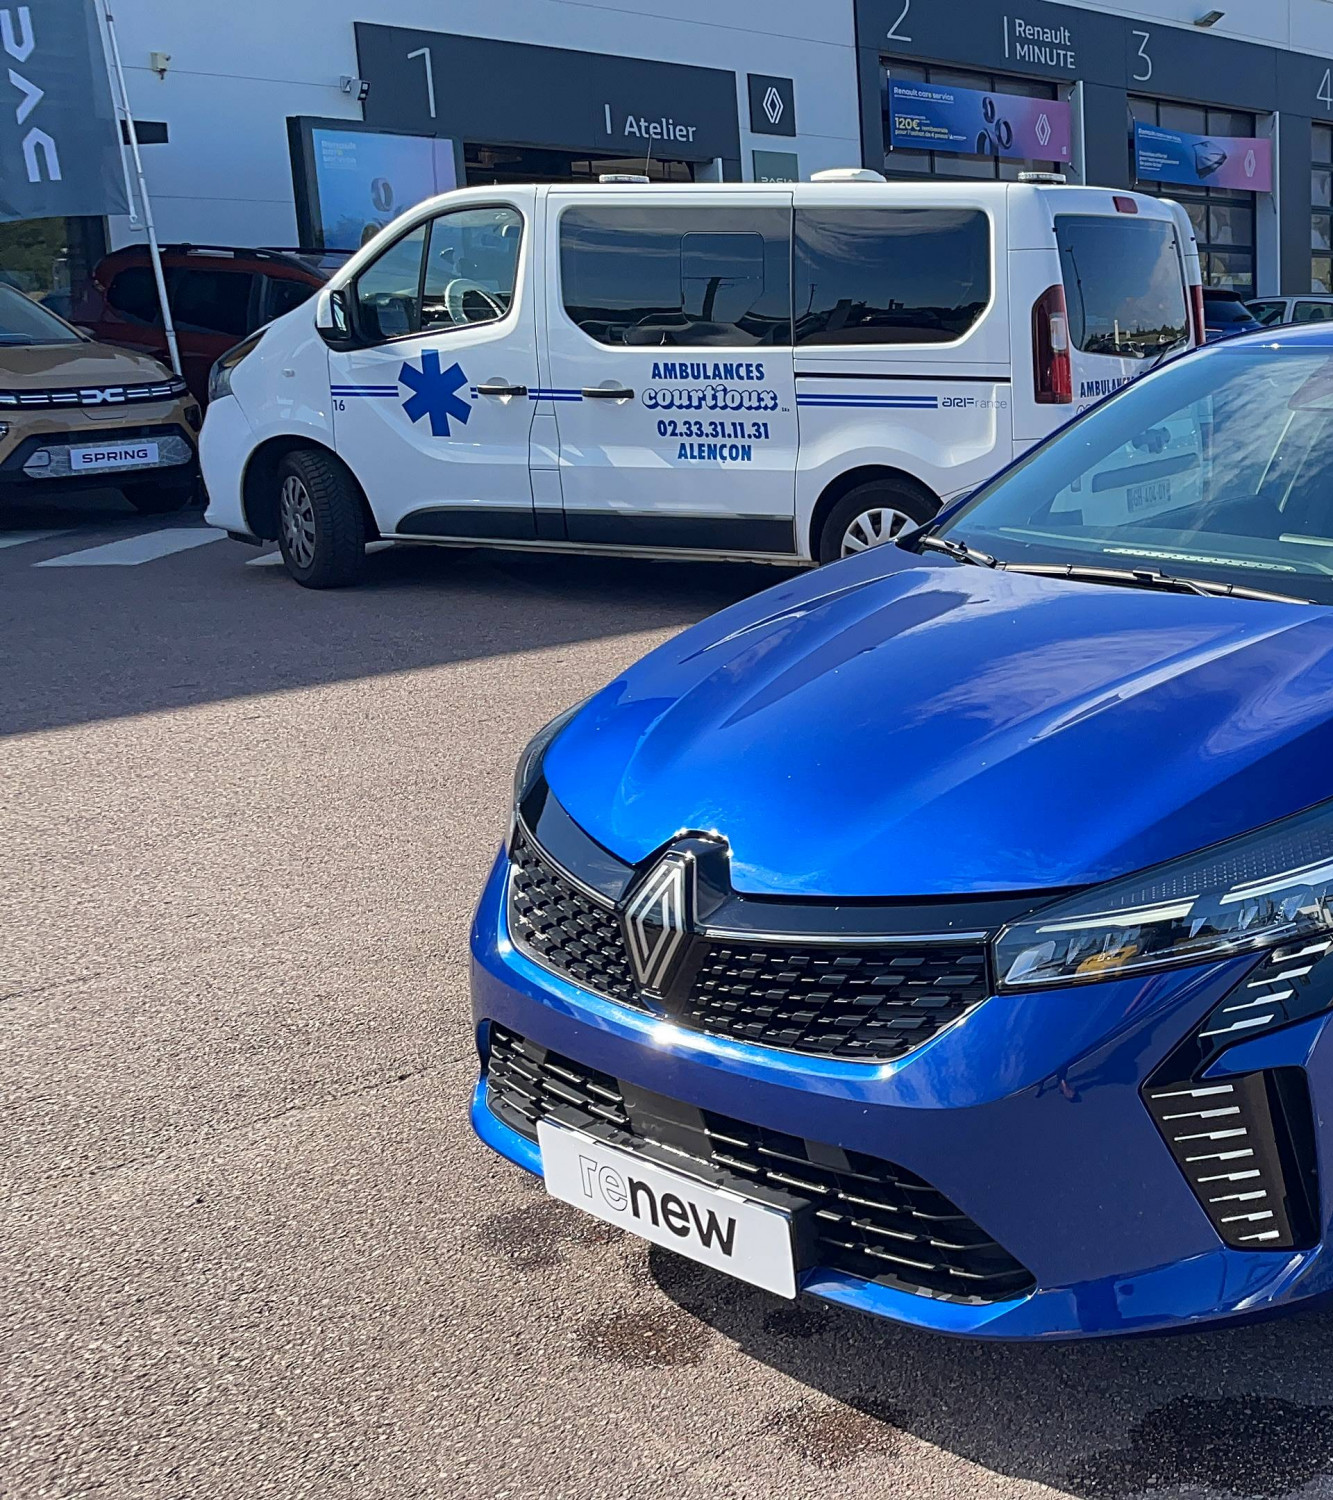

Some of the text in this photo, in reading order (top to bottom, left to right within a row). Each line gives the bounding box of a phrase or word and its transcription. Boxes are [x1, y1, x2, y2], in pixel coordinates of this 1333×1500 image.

[1014, 18, 1072, 46] Renault
[1016, 42, 1077, 69] MINUTE
[1132, 30, 1153, 81] 3
[407, 47, 437, 118] 1
[893, 86, 918, 96] Renault
[1316, 68, 1333, 111] 4
[624, 115, 697, 142] Atelier
[894, 117, 920, 130] 120€
[651, 362, 765, 381] AMBULANCES
[641, 383, 779, 412] courtioux
[1080, 376, 1135, 398] AMBULAN
[333, 399, 345, 411] 16
[657, 419, 770, 440] 02.33.31.11.31
[82, 449, 148, 463] SPRING
[677, 442, 752, 464] ALENÇON
[578, 1153, 737, 1258] renew
